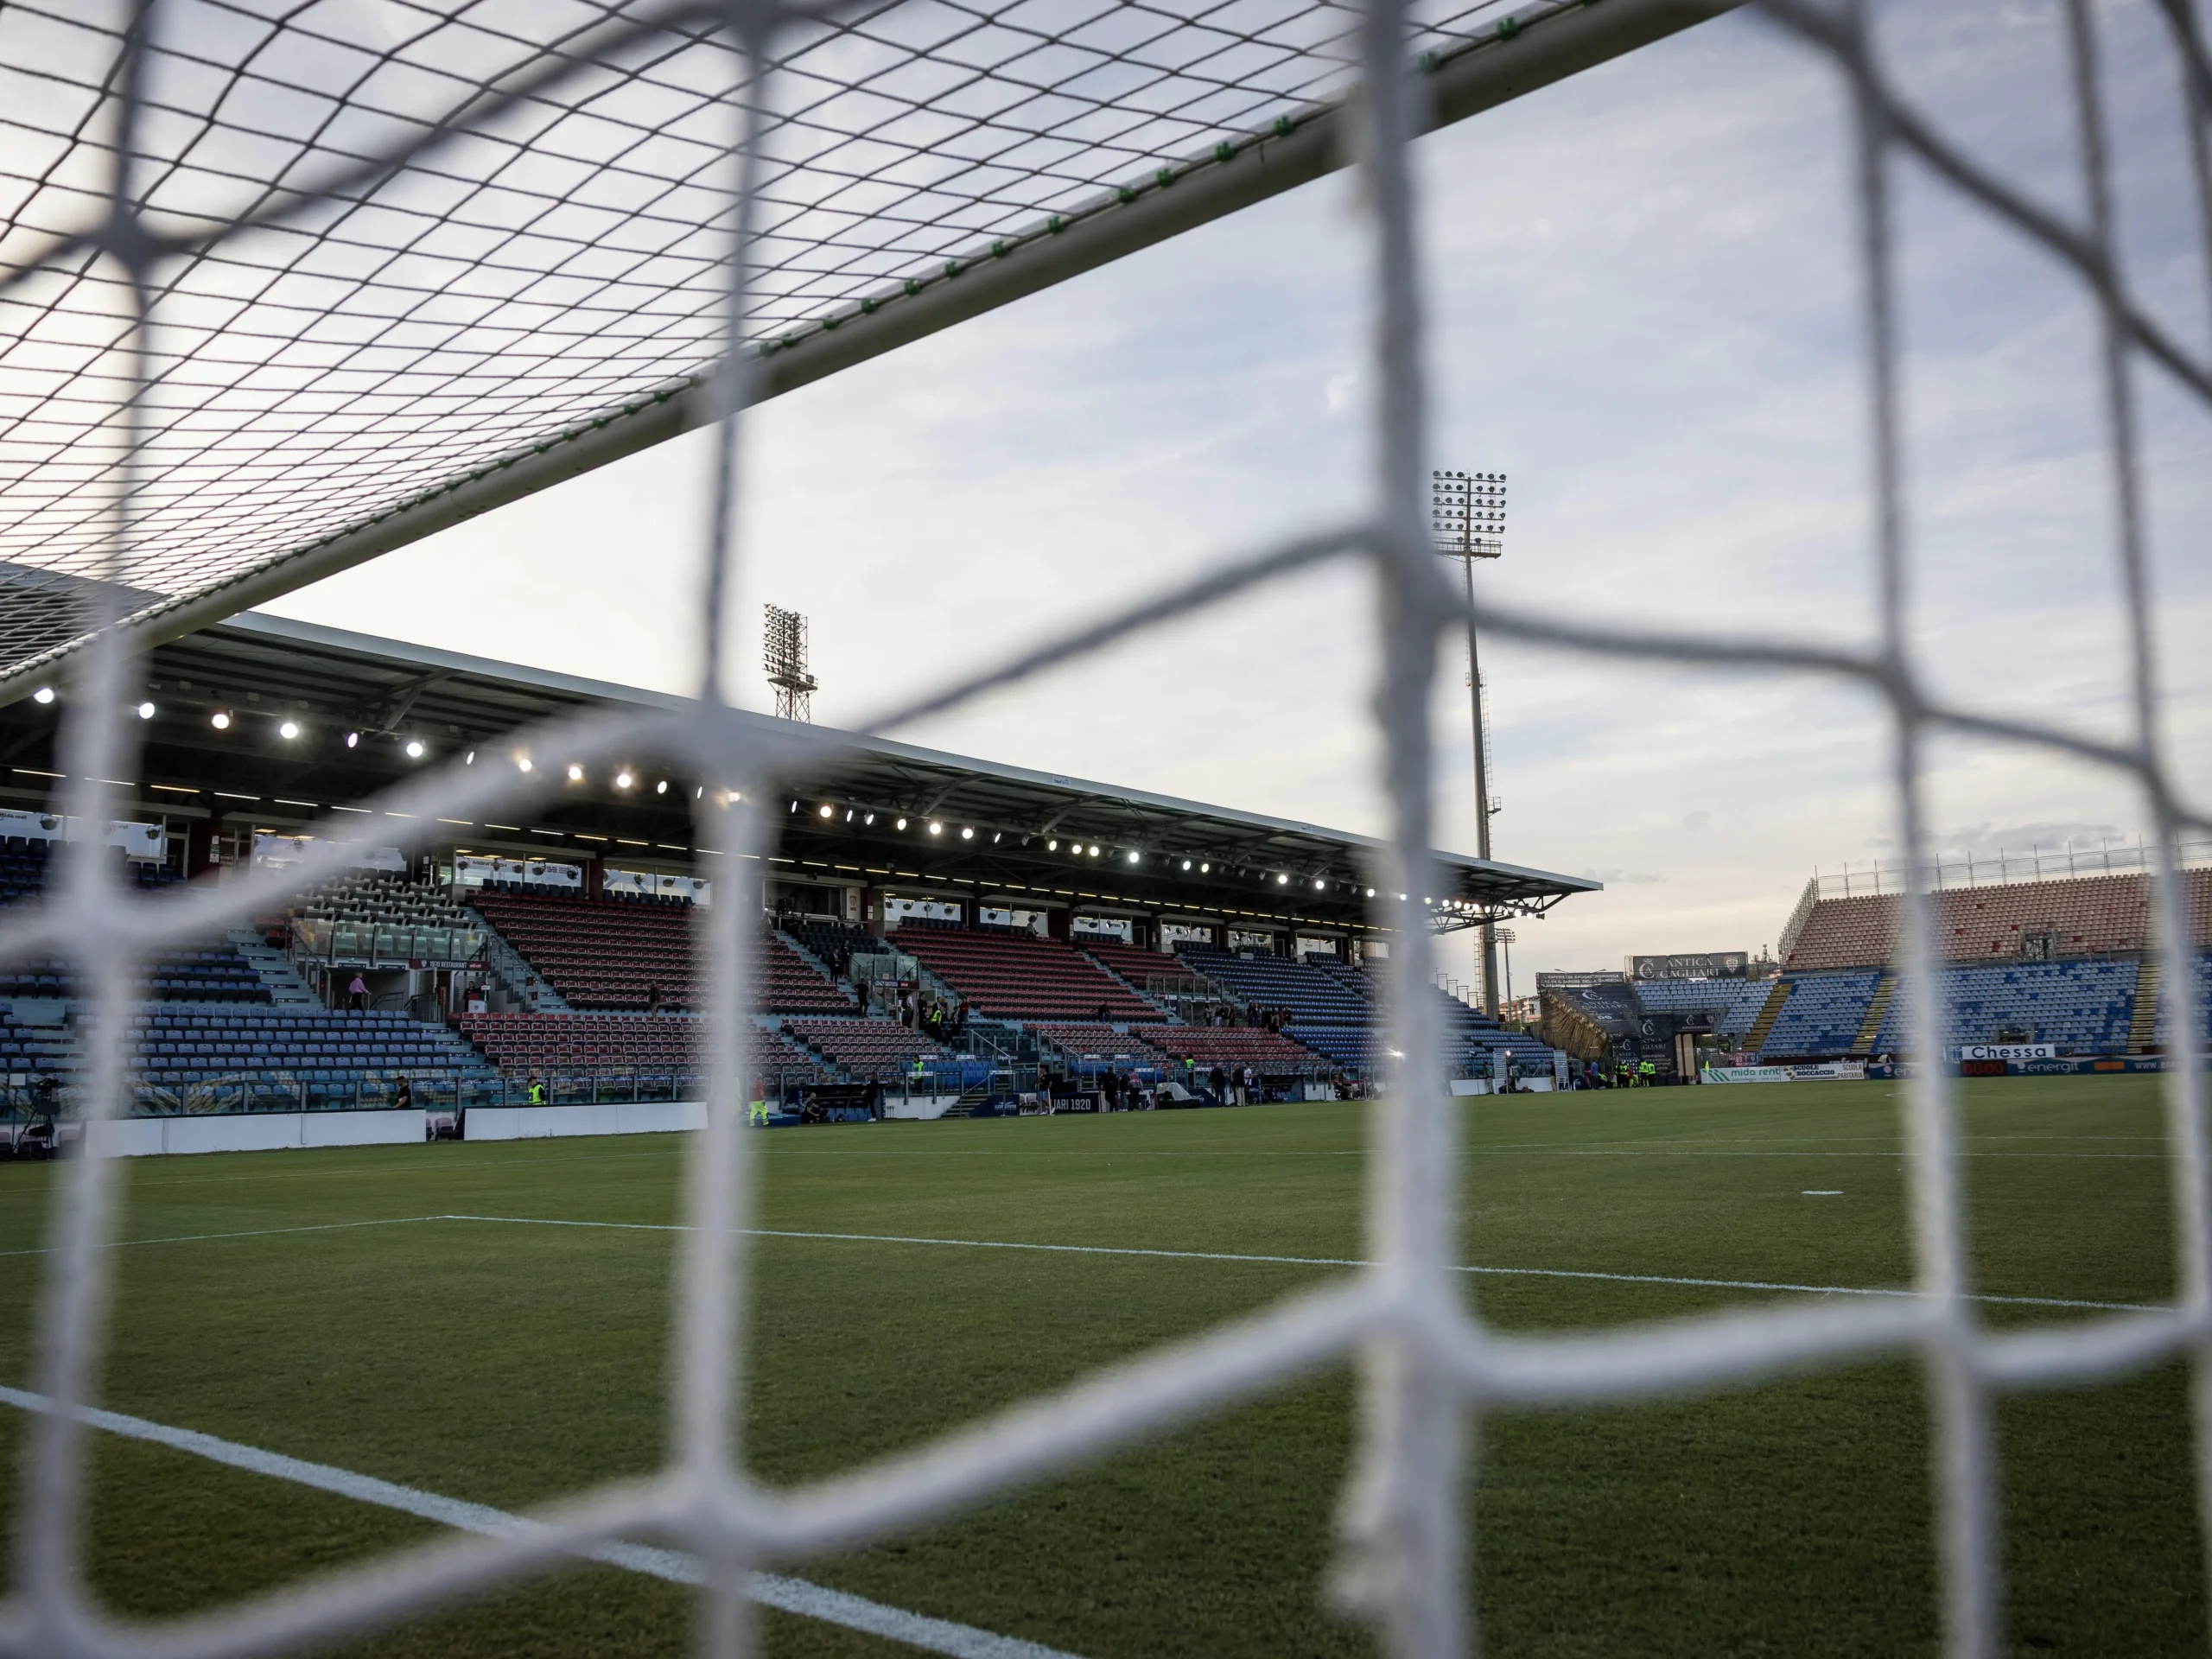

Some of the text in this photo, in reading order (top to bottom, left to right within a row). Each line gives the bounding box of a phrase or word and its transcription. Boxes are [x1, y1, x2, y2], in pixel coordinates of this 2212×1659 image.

[441, 960, 467, 969] RESTAURANT
[1666, 957, 1713, 968] ANTICA
[1660, 968, 1719, 979] CAGLIARI
[1972, 1046, 2047, 1058] Chessa
[1731, 1067, 1780, 1077] mida rent
[1964, 1061, 2005, 1075] 00:00
[2027, 1060, 2080, 1075] energit
[1071, 1098, 1091, 1110] 1920
